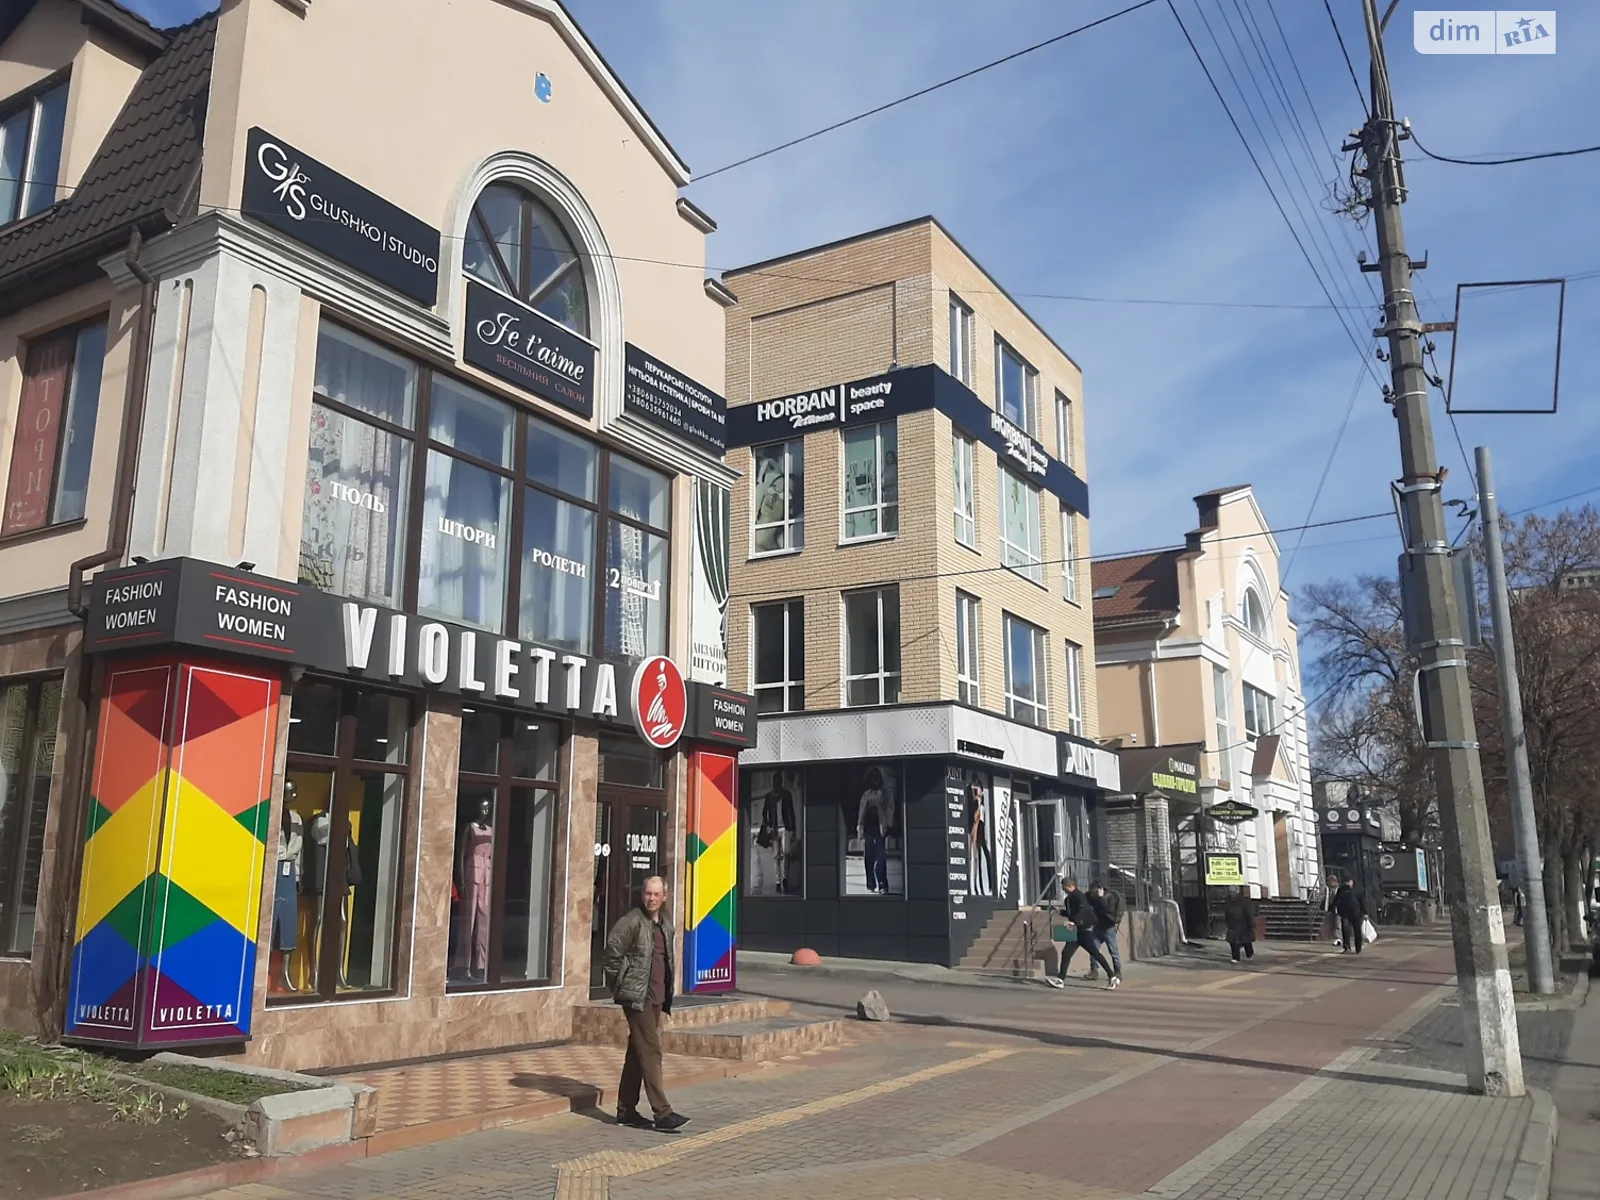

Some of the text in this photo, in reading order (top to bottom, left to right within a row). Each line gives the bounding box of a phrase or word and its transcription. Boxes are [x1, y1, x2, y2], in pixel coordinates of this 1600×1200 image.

[310, 193, 437, 273] GLUSHKO STUDIO
[477, 312, 520, 346] Je
[496, 354, 585, 403] ВЕСІЛЬНИЙ САЛОН
[628, 364, 658, 388] НІГТЬОВА
[660, 381, 688, 406] ЕСТЕТИКА
[692, 399, 710, 416] БРОВИ
[645, 361, 713, 406] ПЕРУКАРСЬКІ ПОСЛУГИ
[757, 382, 892, 422] HORBAN beauty
[851, 398, 885, 415] space
[991, 412, 1028, 451] HORBAN
[330, 481, 385, 513] ТЮЛЬ
[438, 517, 496, 549] ШТОРИ
[533, 547, 586, 578] РОЛЕТИ
[105, 581, 163, 604] FASHION
[609, 568, 653, 594] 2 ПОВЕРХ
[216, 585, 291, 616] FASHION
[105, 608, 156, 630] WOMEN
[218, 612, 285, 640] WOMEN
[343, 602, 618, 717] VIOLETTA
[693, 656, 726, 674] ШТОР
[713, 699, 745, 716] FASHION
[715, 716, 744, 732] WOMEN
[997, 790, 1009, 848] НОВА
[698, 968, 728, 979] VIOLETTA
[80, 1004, 130, 1022] VIOLETTA
[160, 1004, 232, 1022] VIOLETTA
